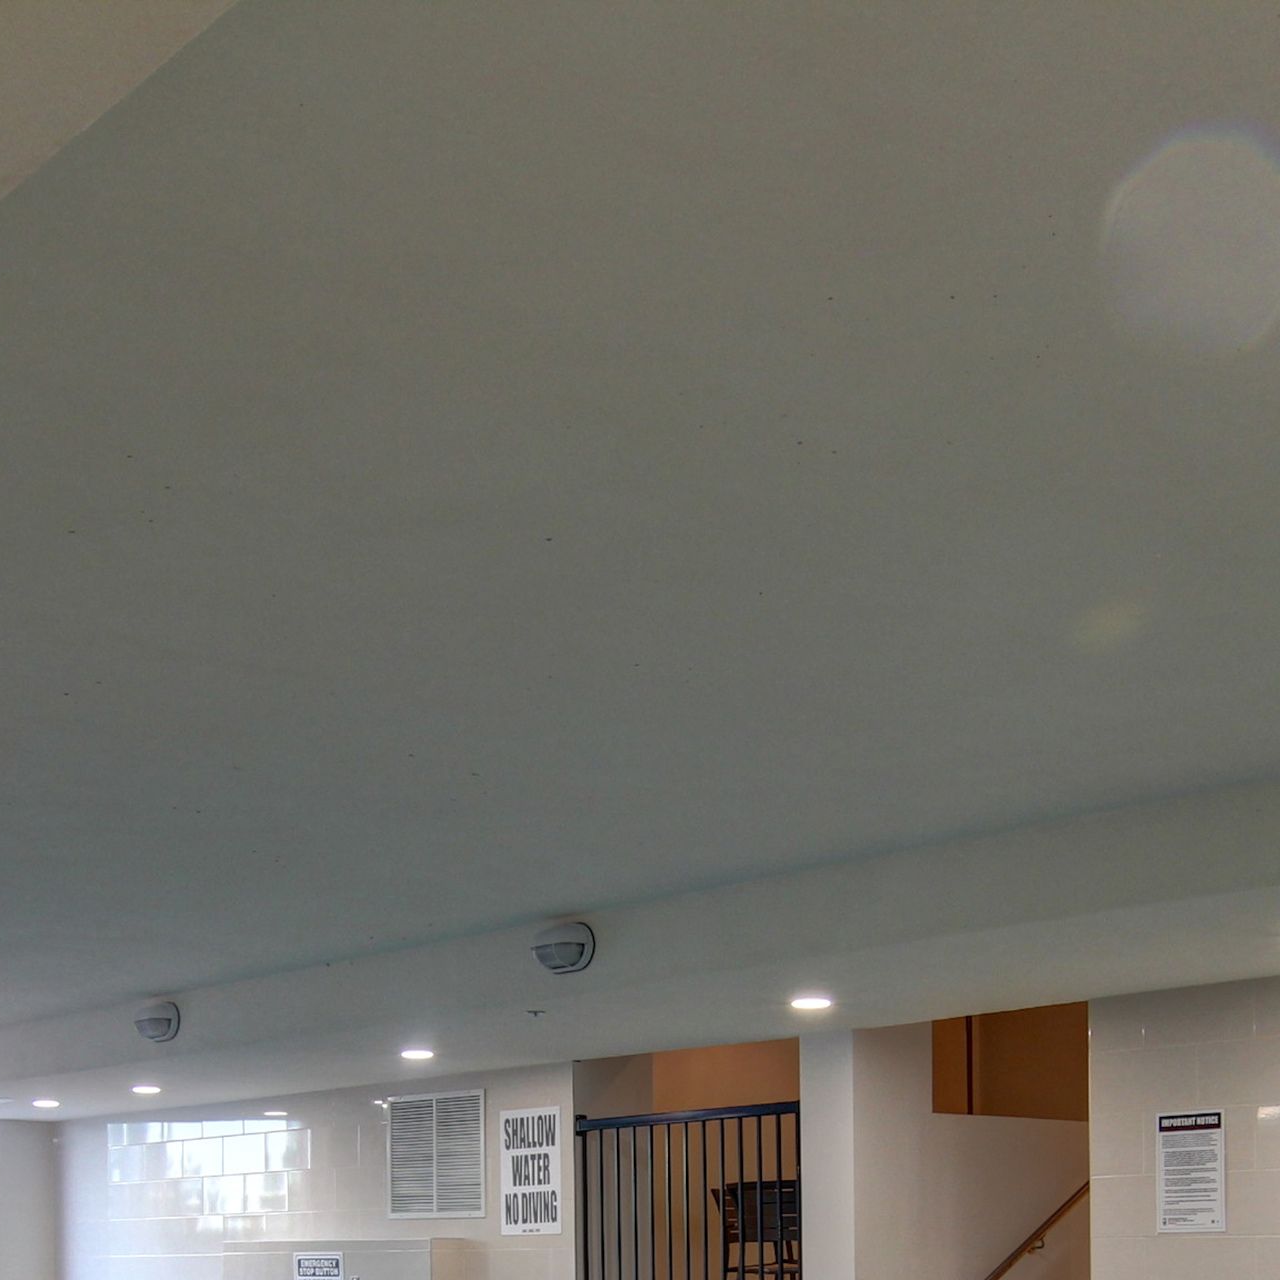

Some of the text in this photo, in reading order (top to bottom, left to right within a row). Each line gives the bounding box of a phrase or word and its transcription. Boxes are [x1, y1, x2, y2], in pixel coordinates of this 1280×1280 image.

[504, 1114, 556, 1150] SHALLOW
[1161, 1115, 1219, 1128] IMPORTANT NOTICE
[511, 1153, 550, 1187] WATER
[505, 1190, 557, 1225] NO DIVING
[299, 1267, 339, 1276] STOP BUTTON
[300, 1259, 337, 1268] EMERGENCY
